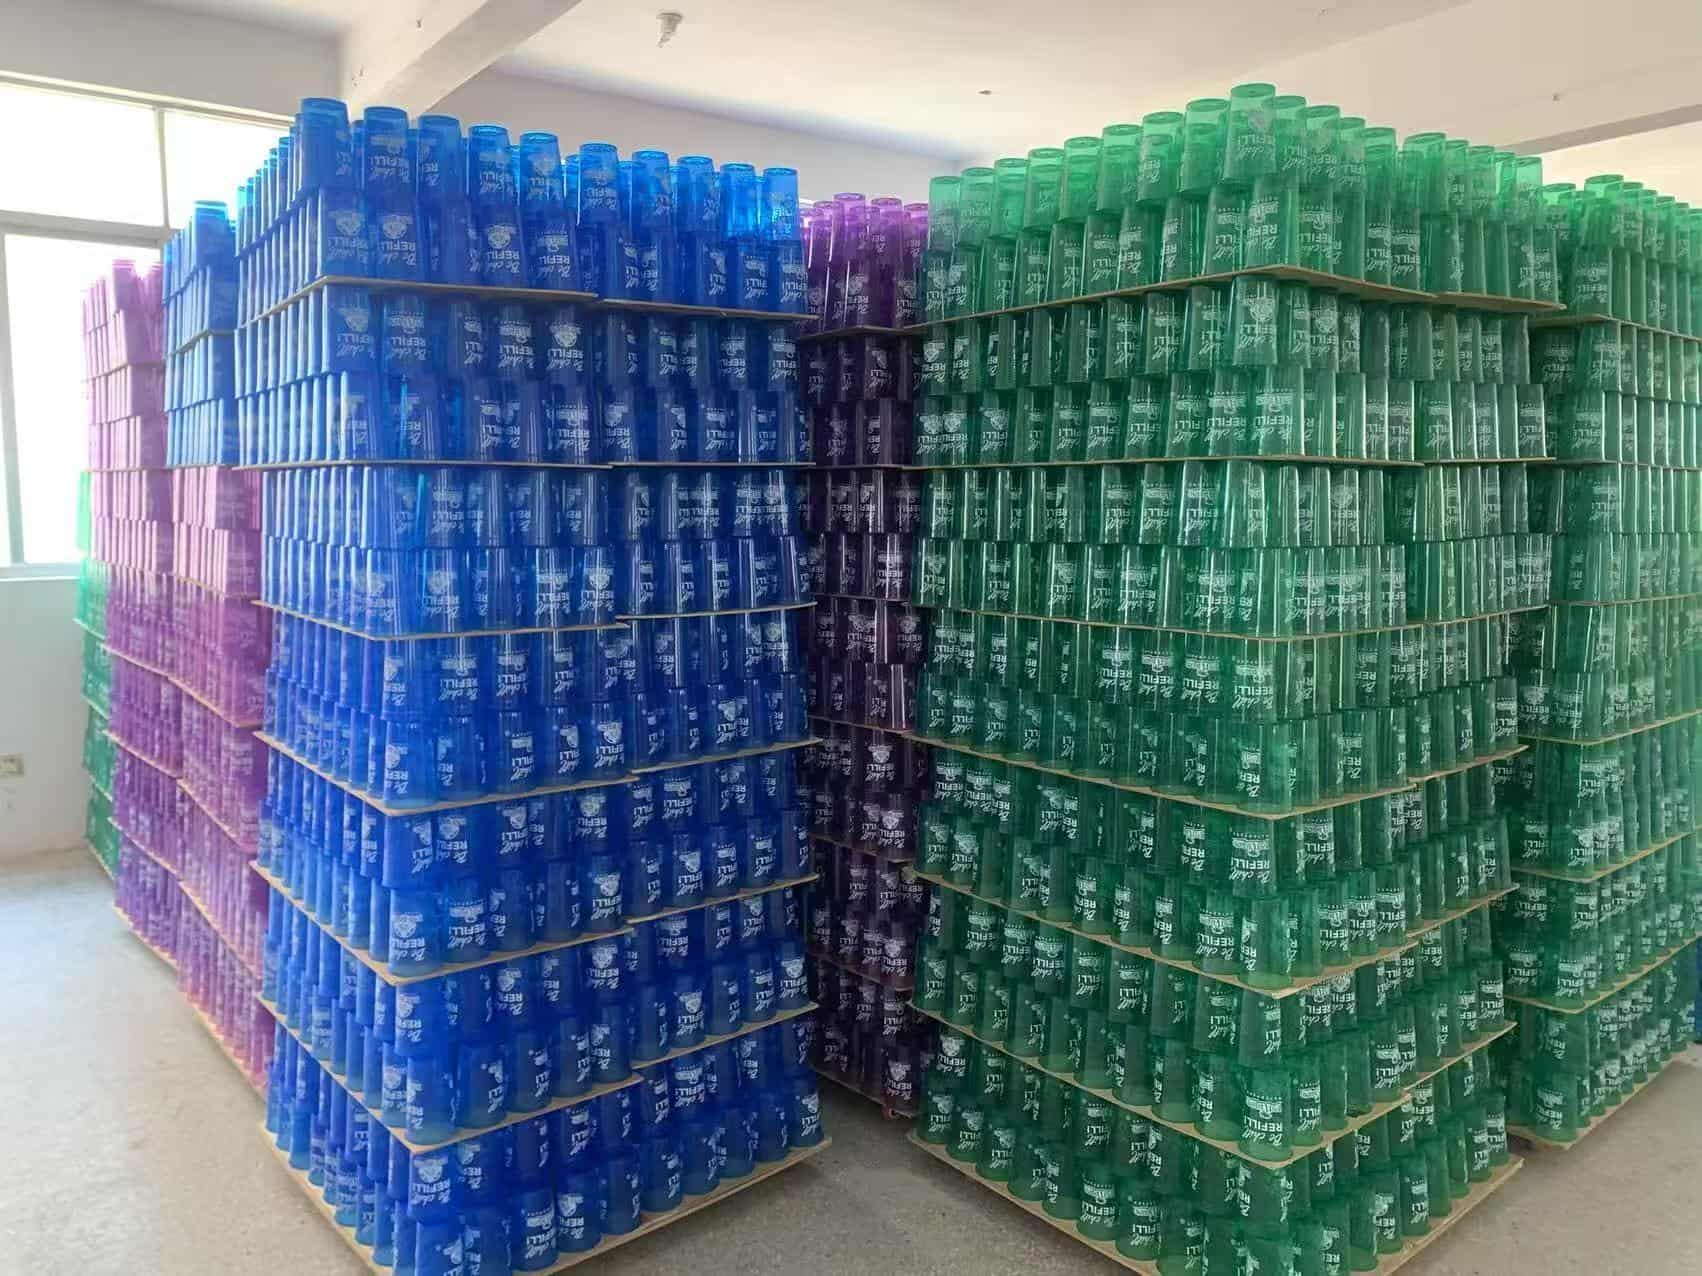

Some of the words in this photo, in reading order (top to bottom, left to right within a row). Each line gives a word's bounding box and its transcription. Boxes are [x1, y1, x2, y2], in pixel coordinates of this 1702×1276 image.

[394, 780, 408, 793] Be
[1247, 785, 1259, 798] Be
[1191, 859, 1204, 871] Be
[1258, 871, 1270, 884] Be
[1220, 947, 1234, 960] Be
[508, 1003, 522, 1015] Be
[408, 1030, 421, 1041] Be
[1269, 1133, 1282, 1146] Be
